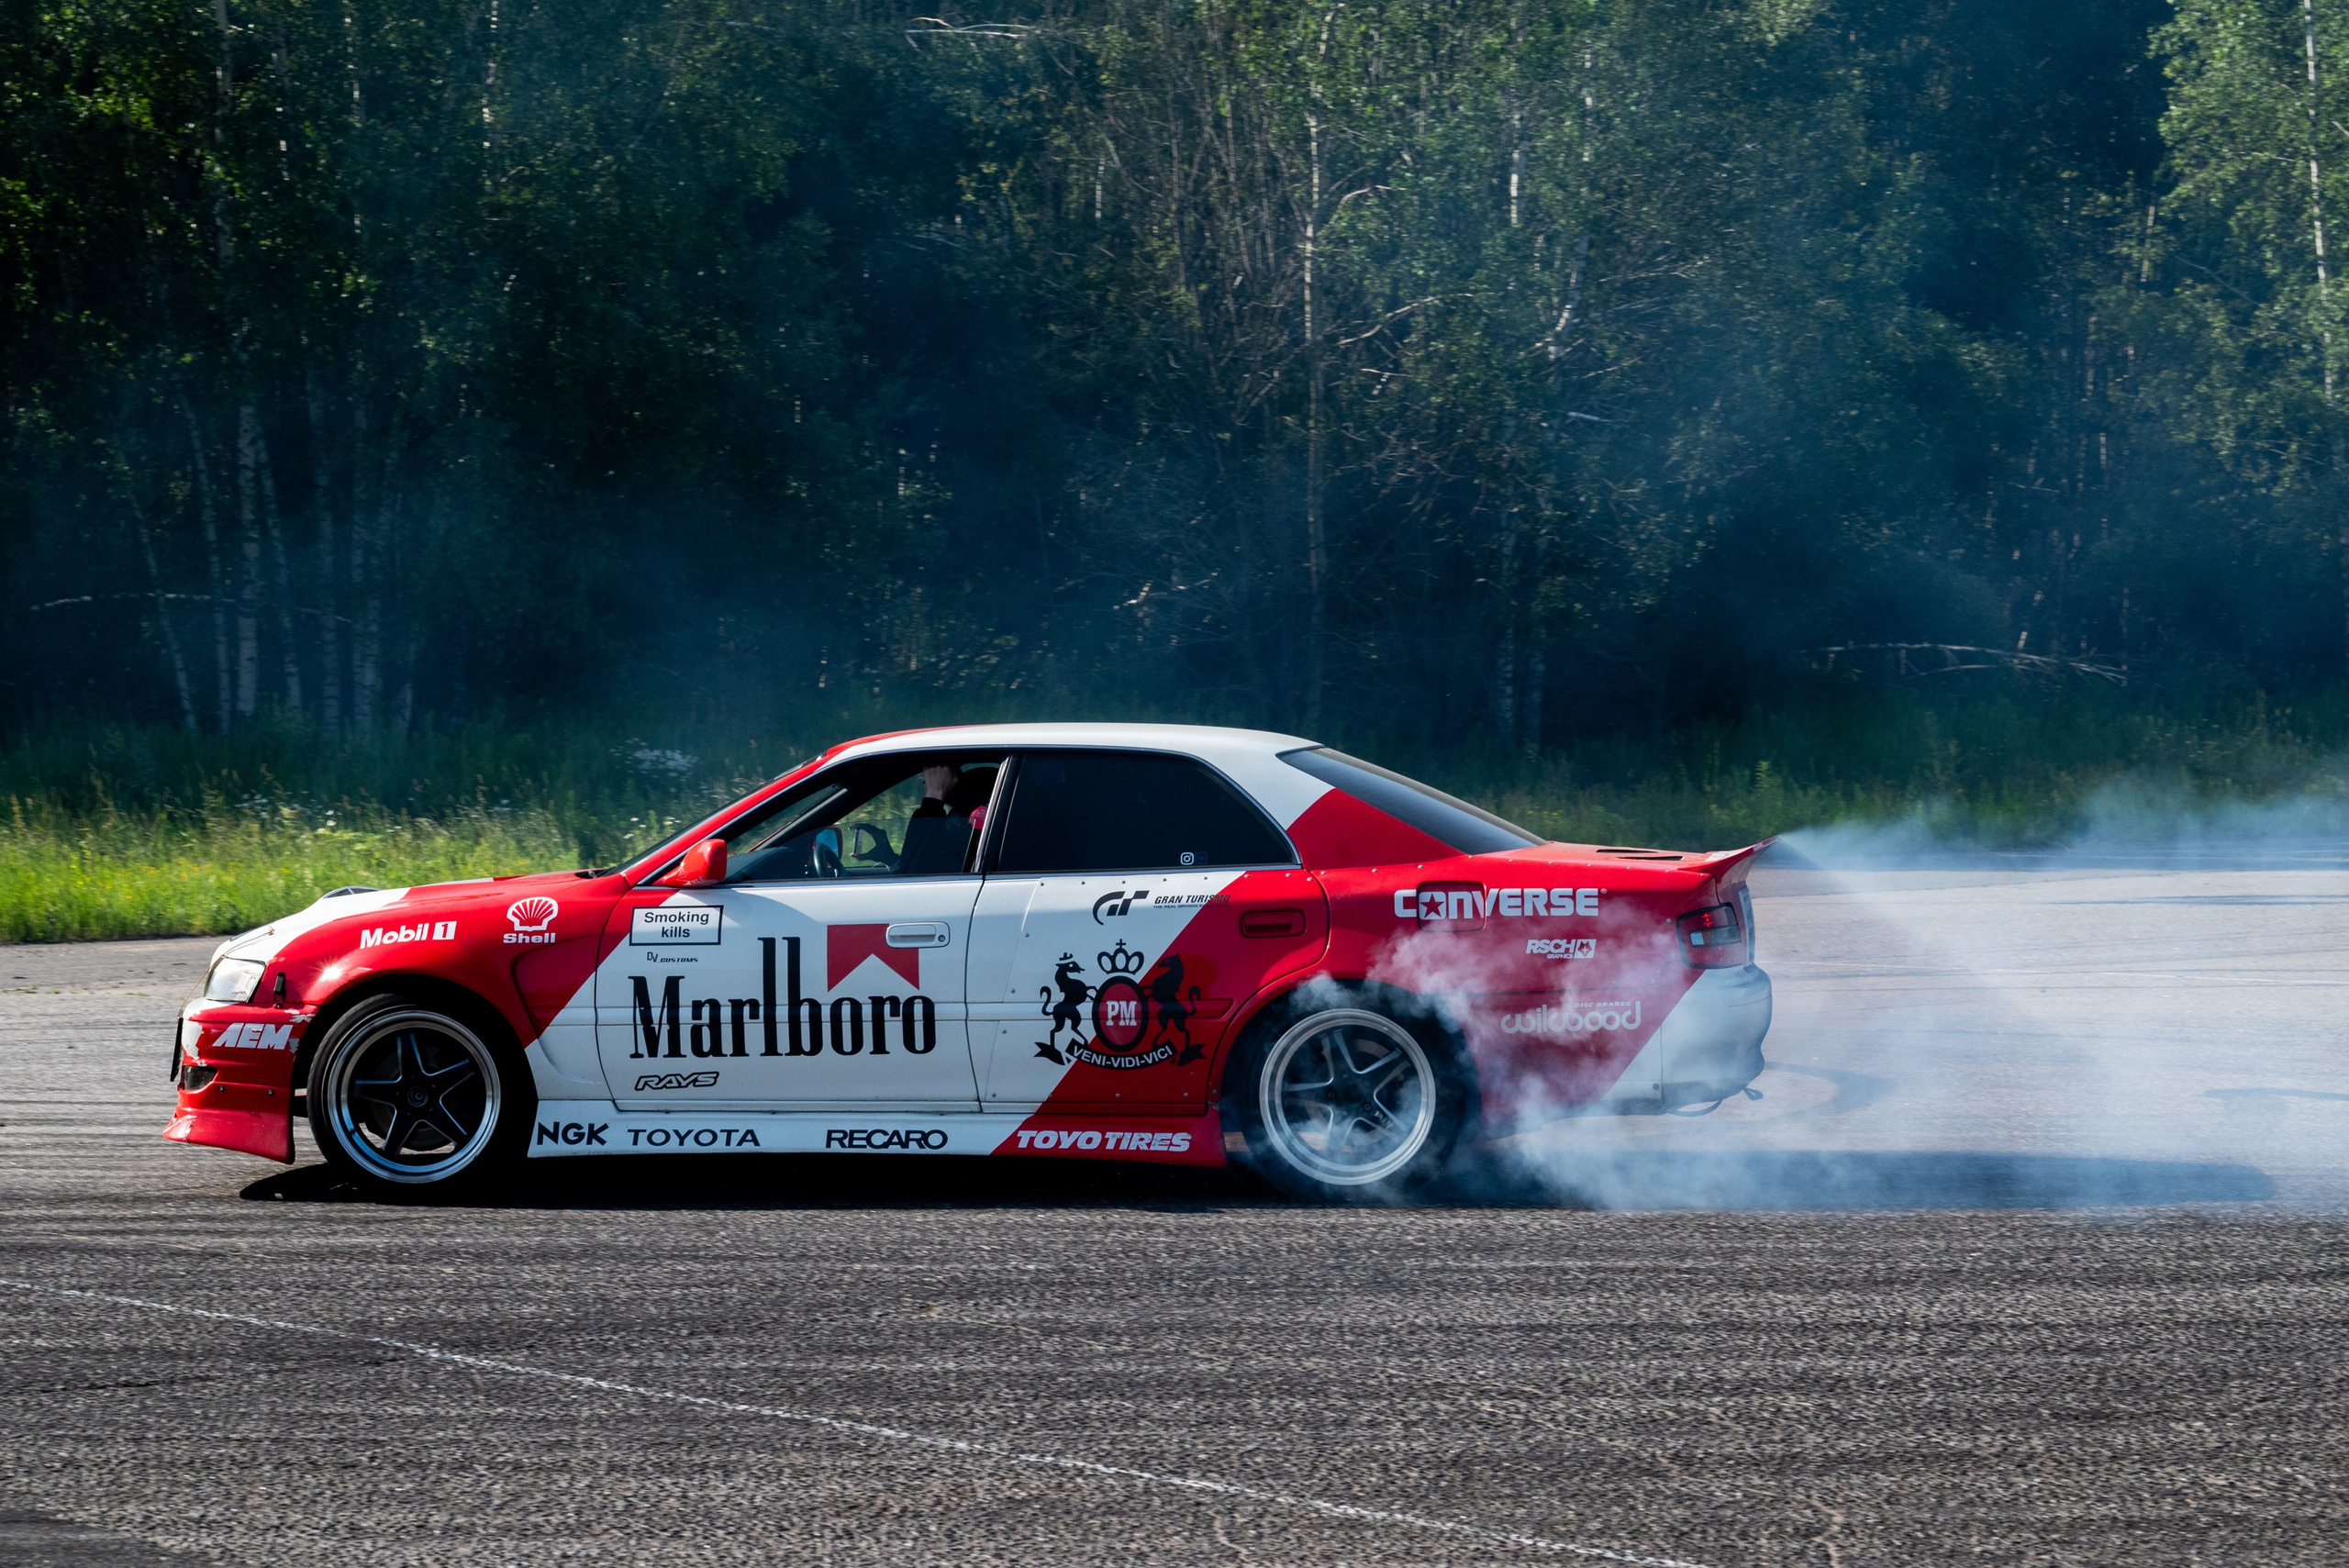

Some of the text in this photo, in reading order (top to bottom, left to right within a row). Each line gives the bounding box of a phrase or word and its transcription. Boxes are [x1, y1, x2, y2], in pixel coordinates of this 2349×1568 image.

[1154, 894, 1231, 905] GRAN TURISMO
[644, 911, 709, 925] Smoking
[360, 923, 429, 950] Mobil
[503, 932, 556, 944] Shell
[661, 926, 690, 938] kills
[1525, 939, 1576, 954] RSCH
[628, 937, 937, 1059] Marlboro
[1106, 1000, 1137, 1027] PM
[212, 1022, 294, 1051] AEM
[1073, 1045, 1174, 1068] VENI-VIDI-VICI
[635, 1072, 719, 1091] RAYS
[537, 1121, 610, 1147] NGK
[628, 1129, 761, 1147] TOYOTA
[826, 1129, 949, 1150] RECARO
[1017, 1130, 1192, 1152] TOYO TIRES
